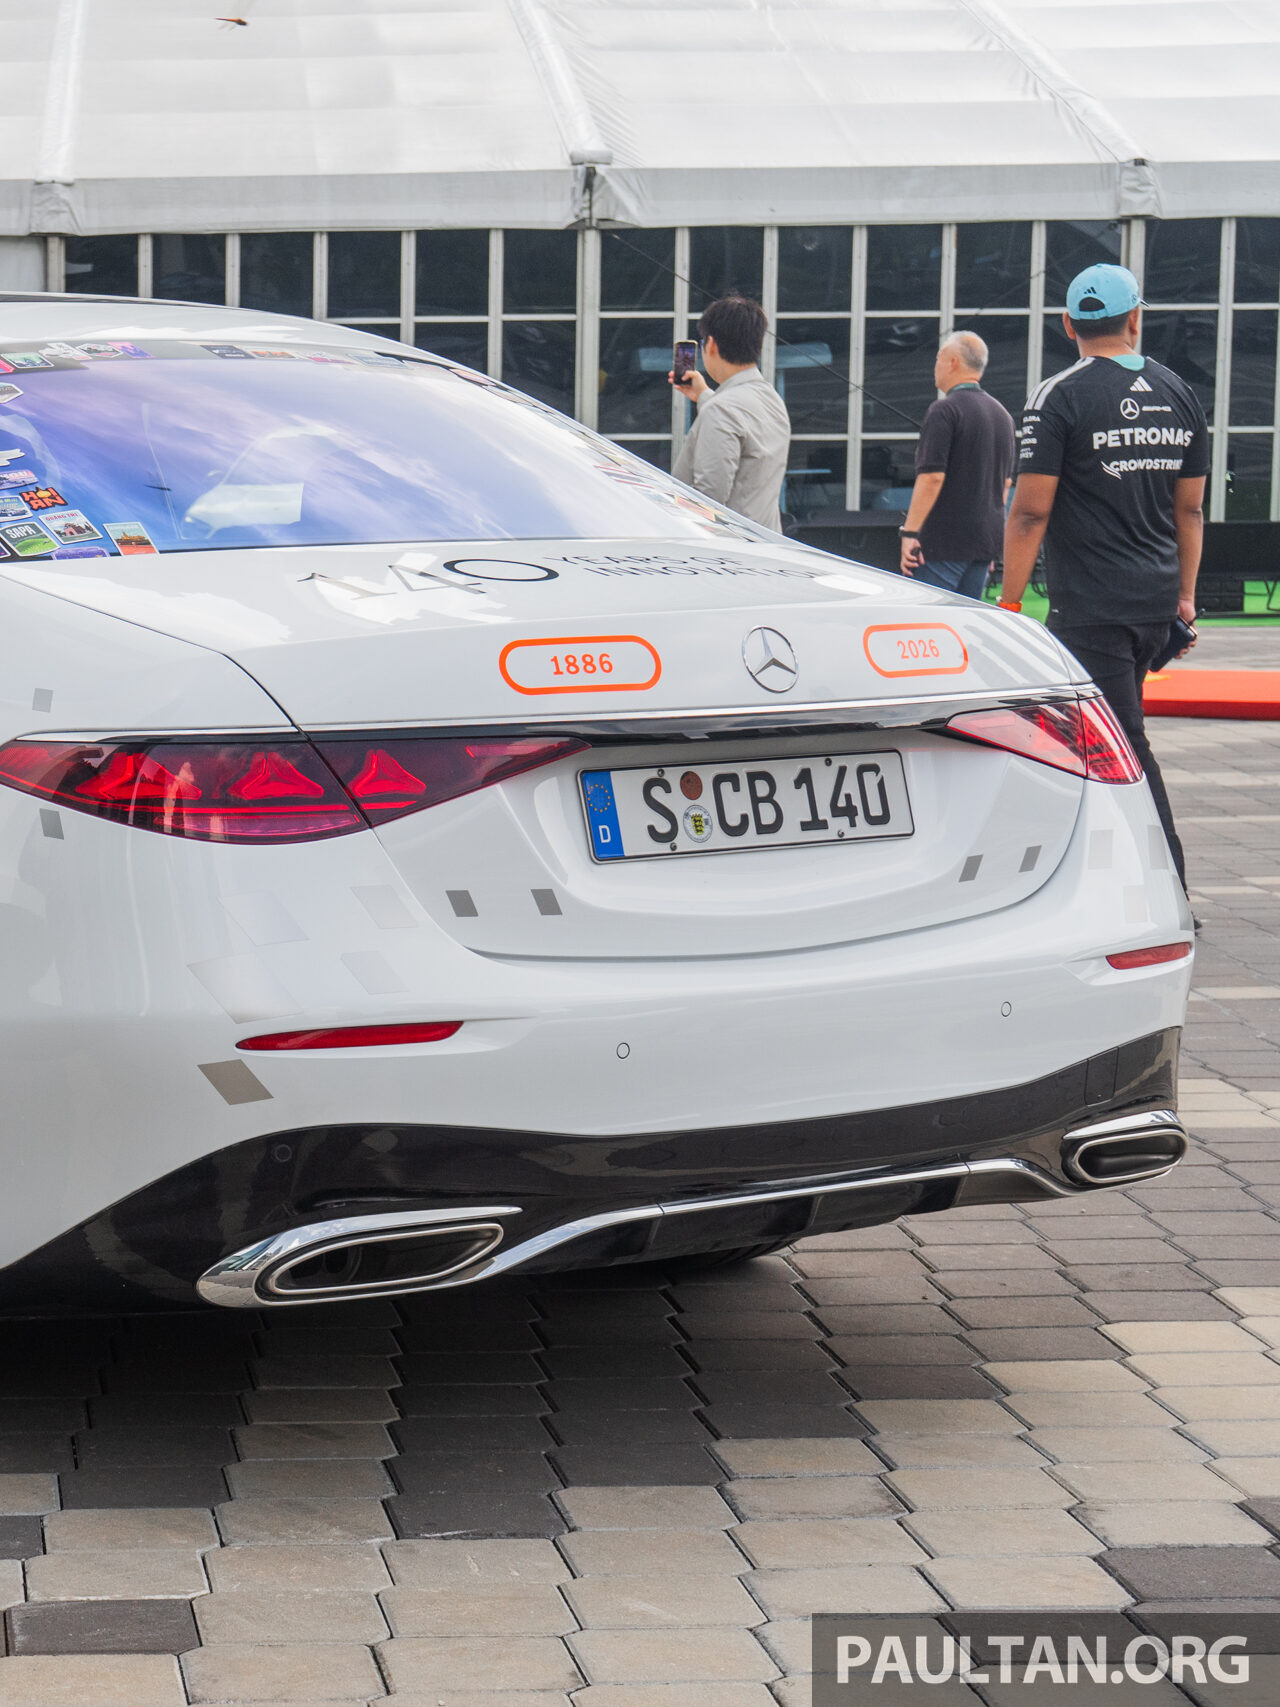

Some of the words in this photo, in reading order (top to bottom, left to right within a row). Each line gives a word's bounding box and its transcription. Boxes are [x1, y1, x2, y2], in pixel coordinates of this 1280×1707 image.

[1093, 427, 1193, 450] PETRONAS
[5, 525, 36, 539] SAPA
[897, 640, 940, 660] 2026
[550, 653, 613, 677] 1886
[642, 777, 678, 843] S
[712, 770, 784, 837] CB
[794, 762, 891, 832] 140
[600, 824, 611, 843] D
